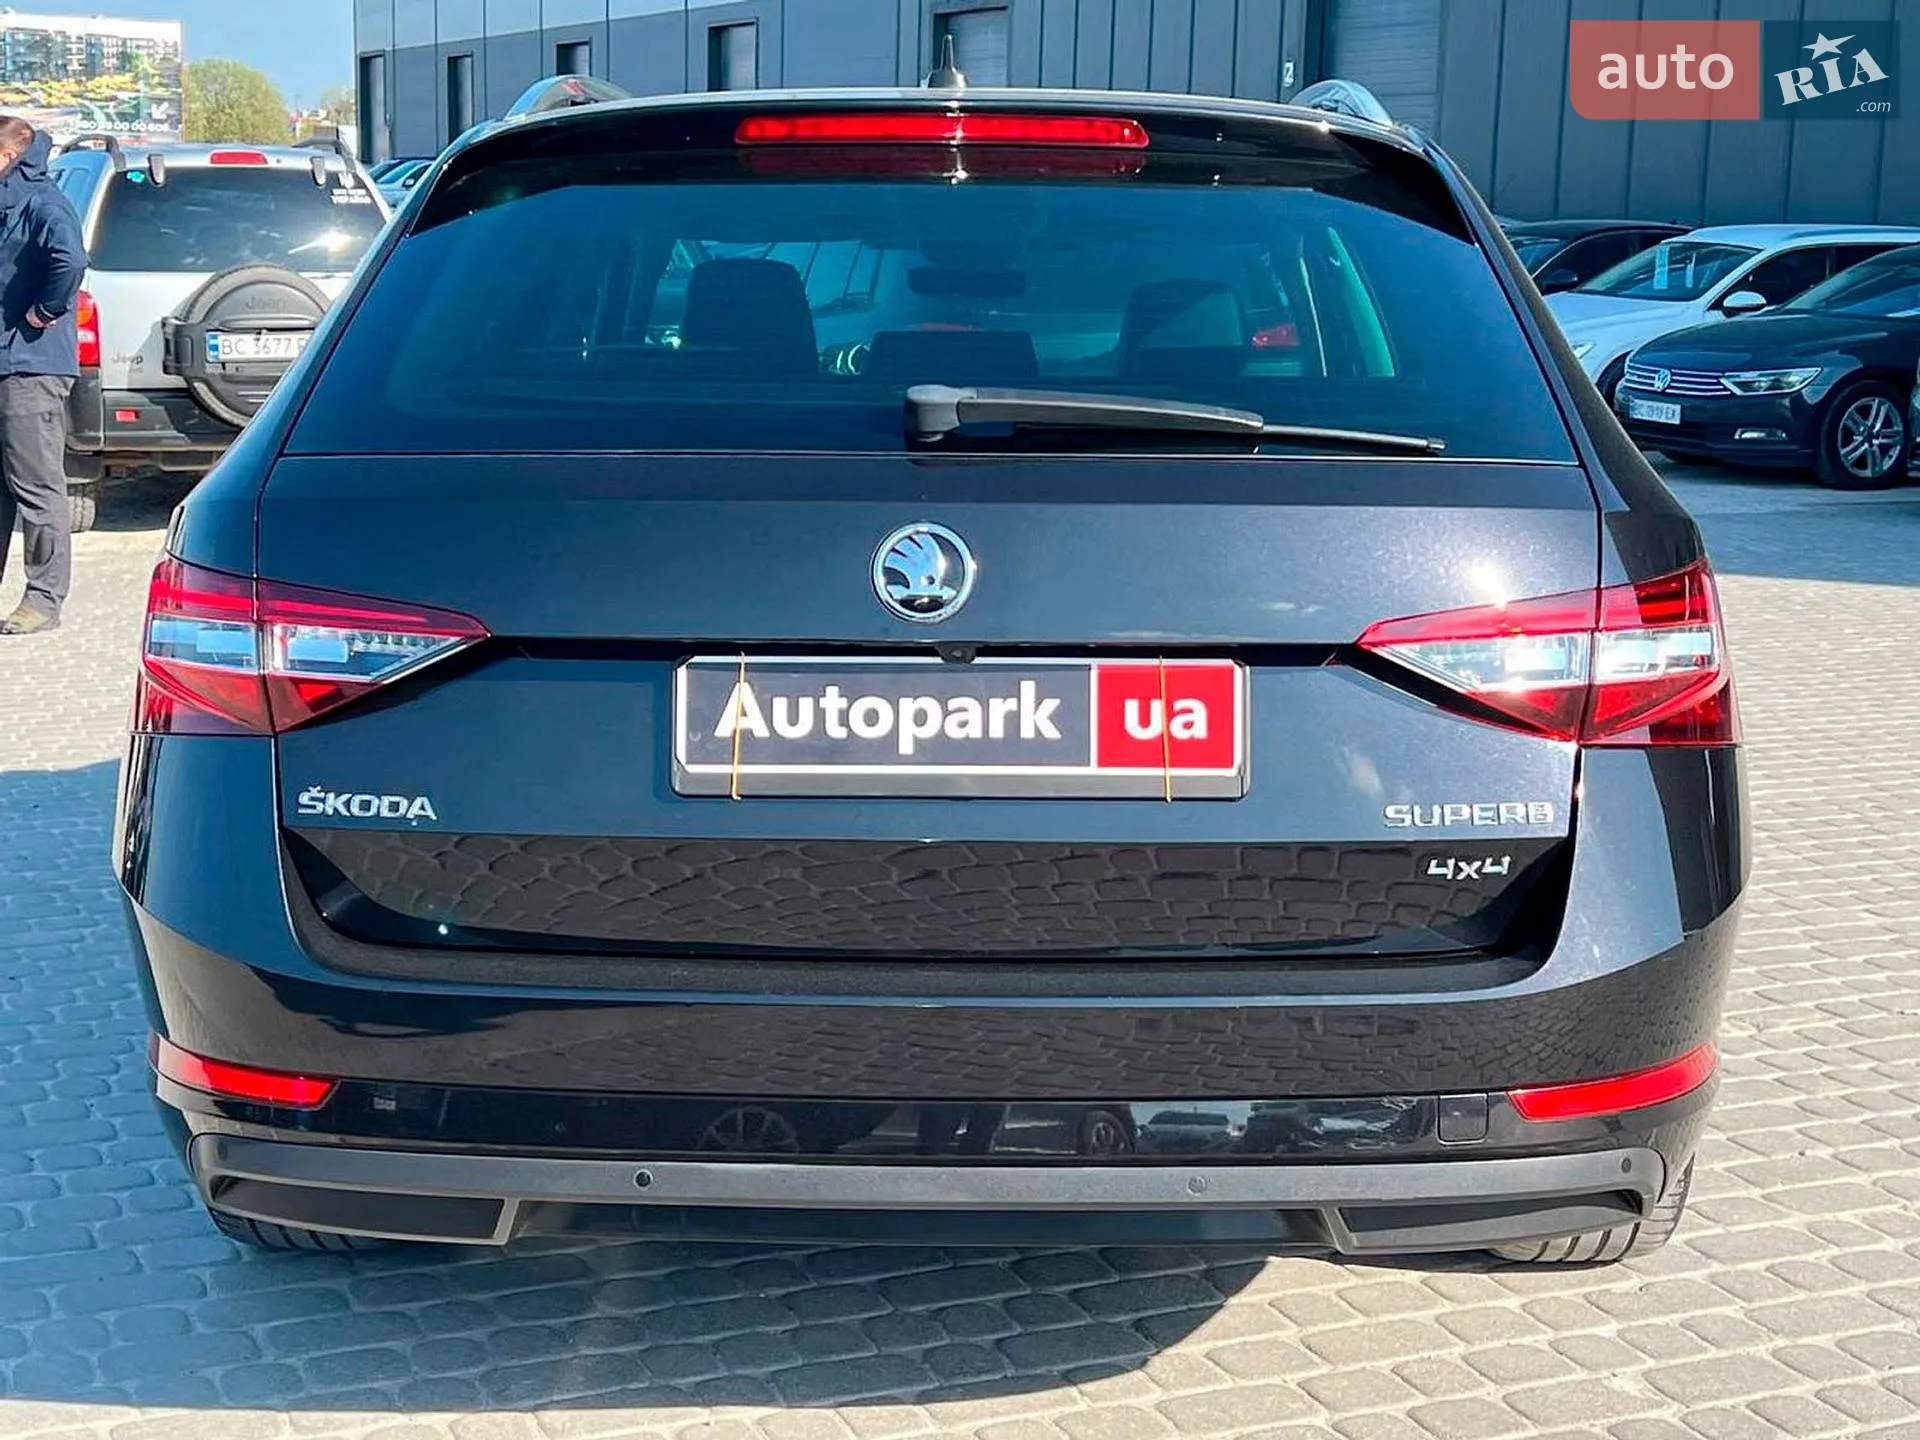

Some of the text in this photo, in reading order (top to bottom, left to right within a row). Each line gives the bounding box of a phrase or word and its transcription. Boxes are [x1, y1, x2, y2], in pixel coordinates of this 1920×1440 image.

[222, 338, 245, 356] BC
[253, 337, 292, 355] 3677
[713, 680, 1208, 755] Autopark ua
[298, 785, 437, 821] ŠKODA
[1384, 802, 1554, 828] SUPERB
[1426, 855, 1512, 880] 4x4
